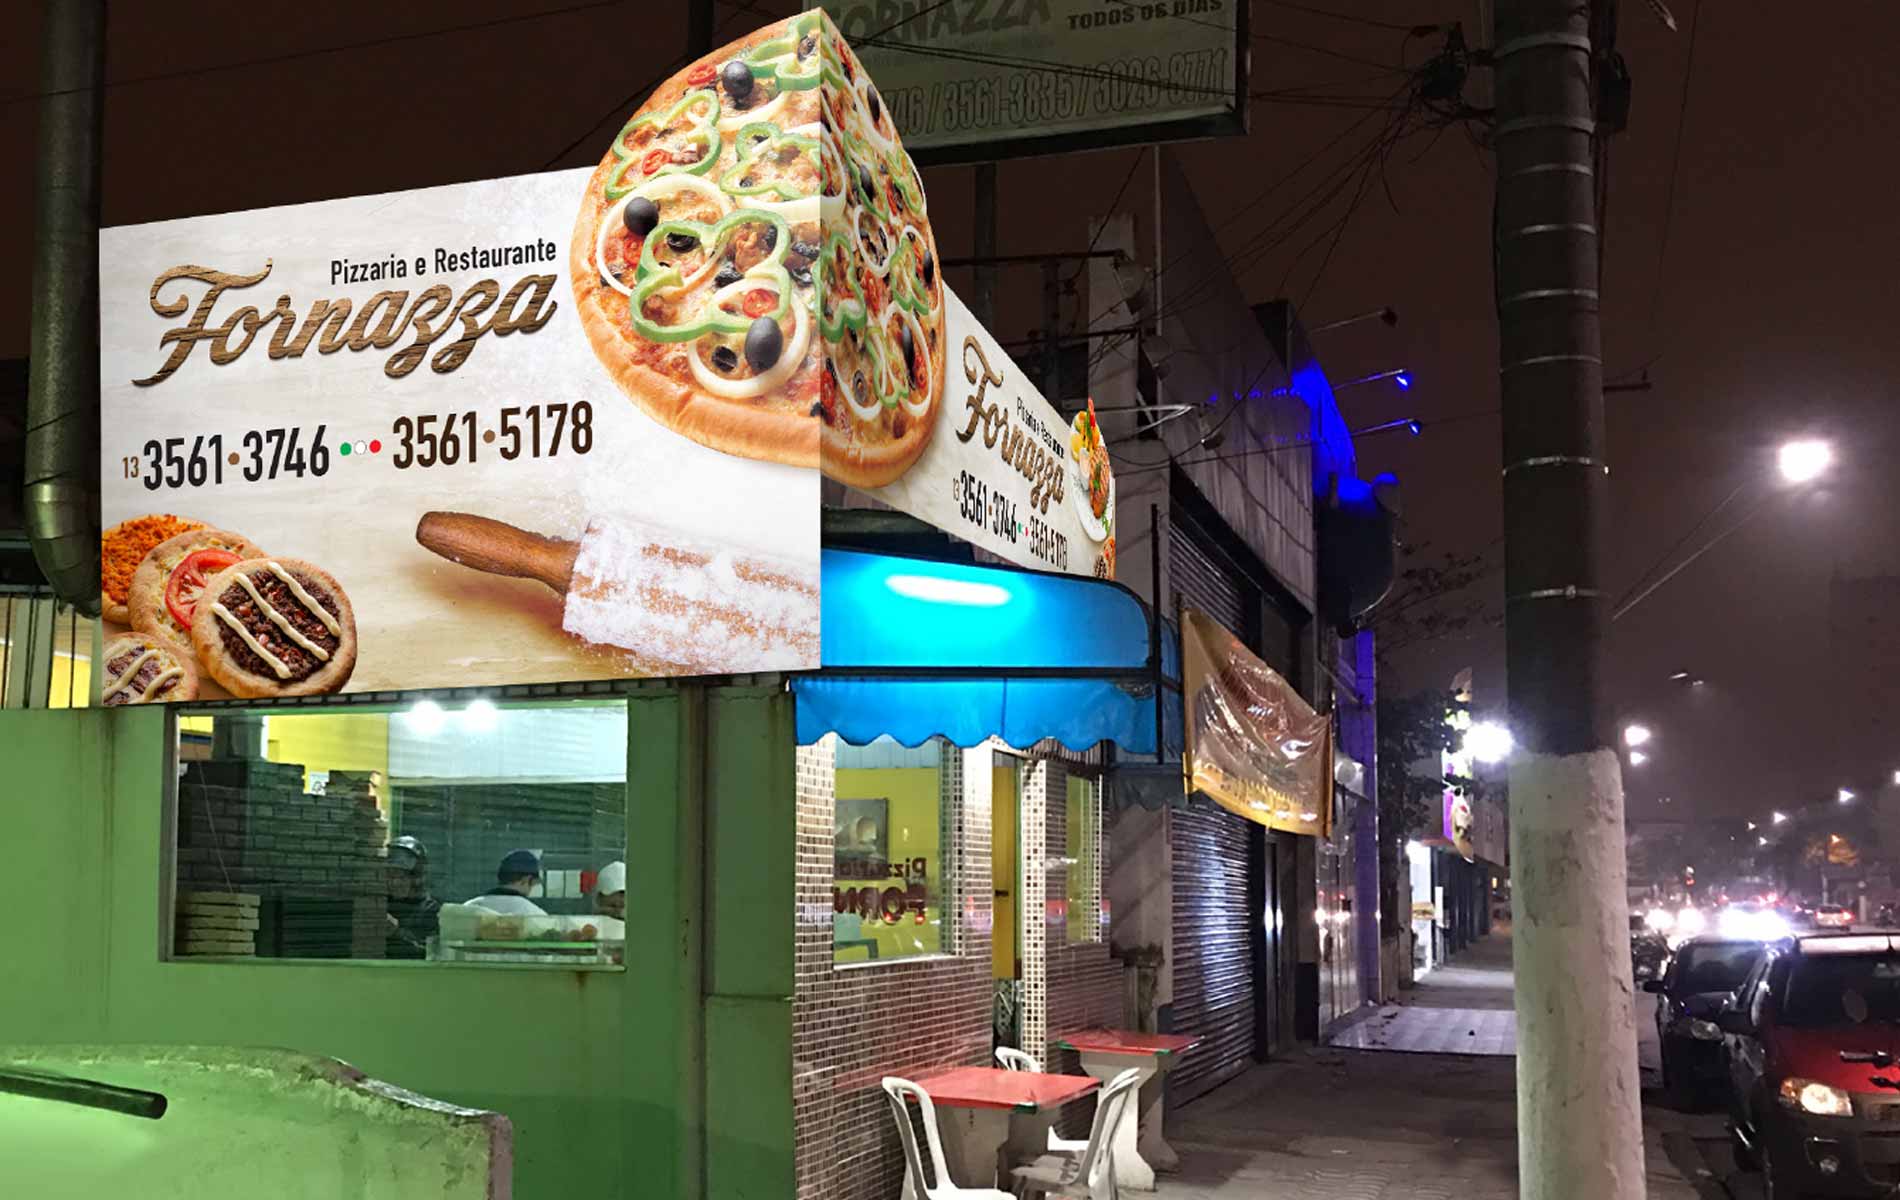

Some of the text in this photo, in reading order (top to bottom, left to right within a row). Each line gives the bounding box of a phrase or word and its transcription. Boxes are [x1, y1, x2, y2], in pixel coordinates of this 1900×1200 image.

[1067, 7, 1134, 30] TODOS
[331, 237, 557, 285] Pizzaria e Restaurante
[131, 257, 558, 387] Fornazza
[956, 334, 1065, 515] Fornazza
[122, 456, 139, 479] 13
